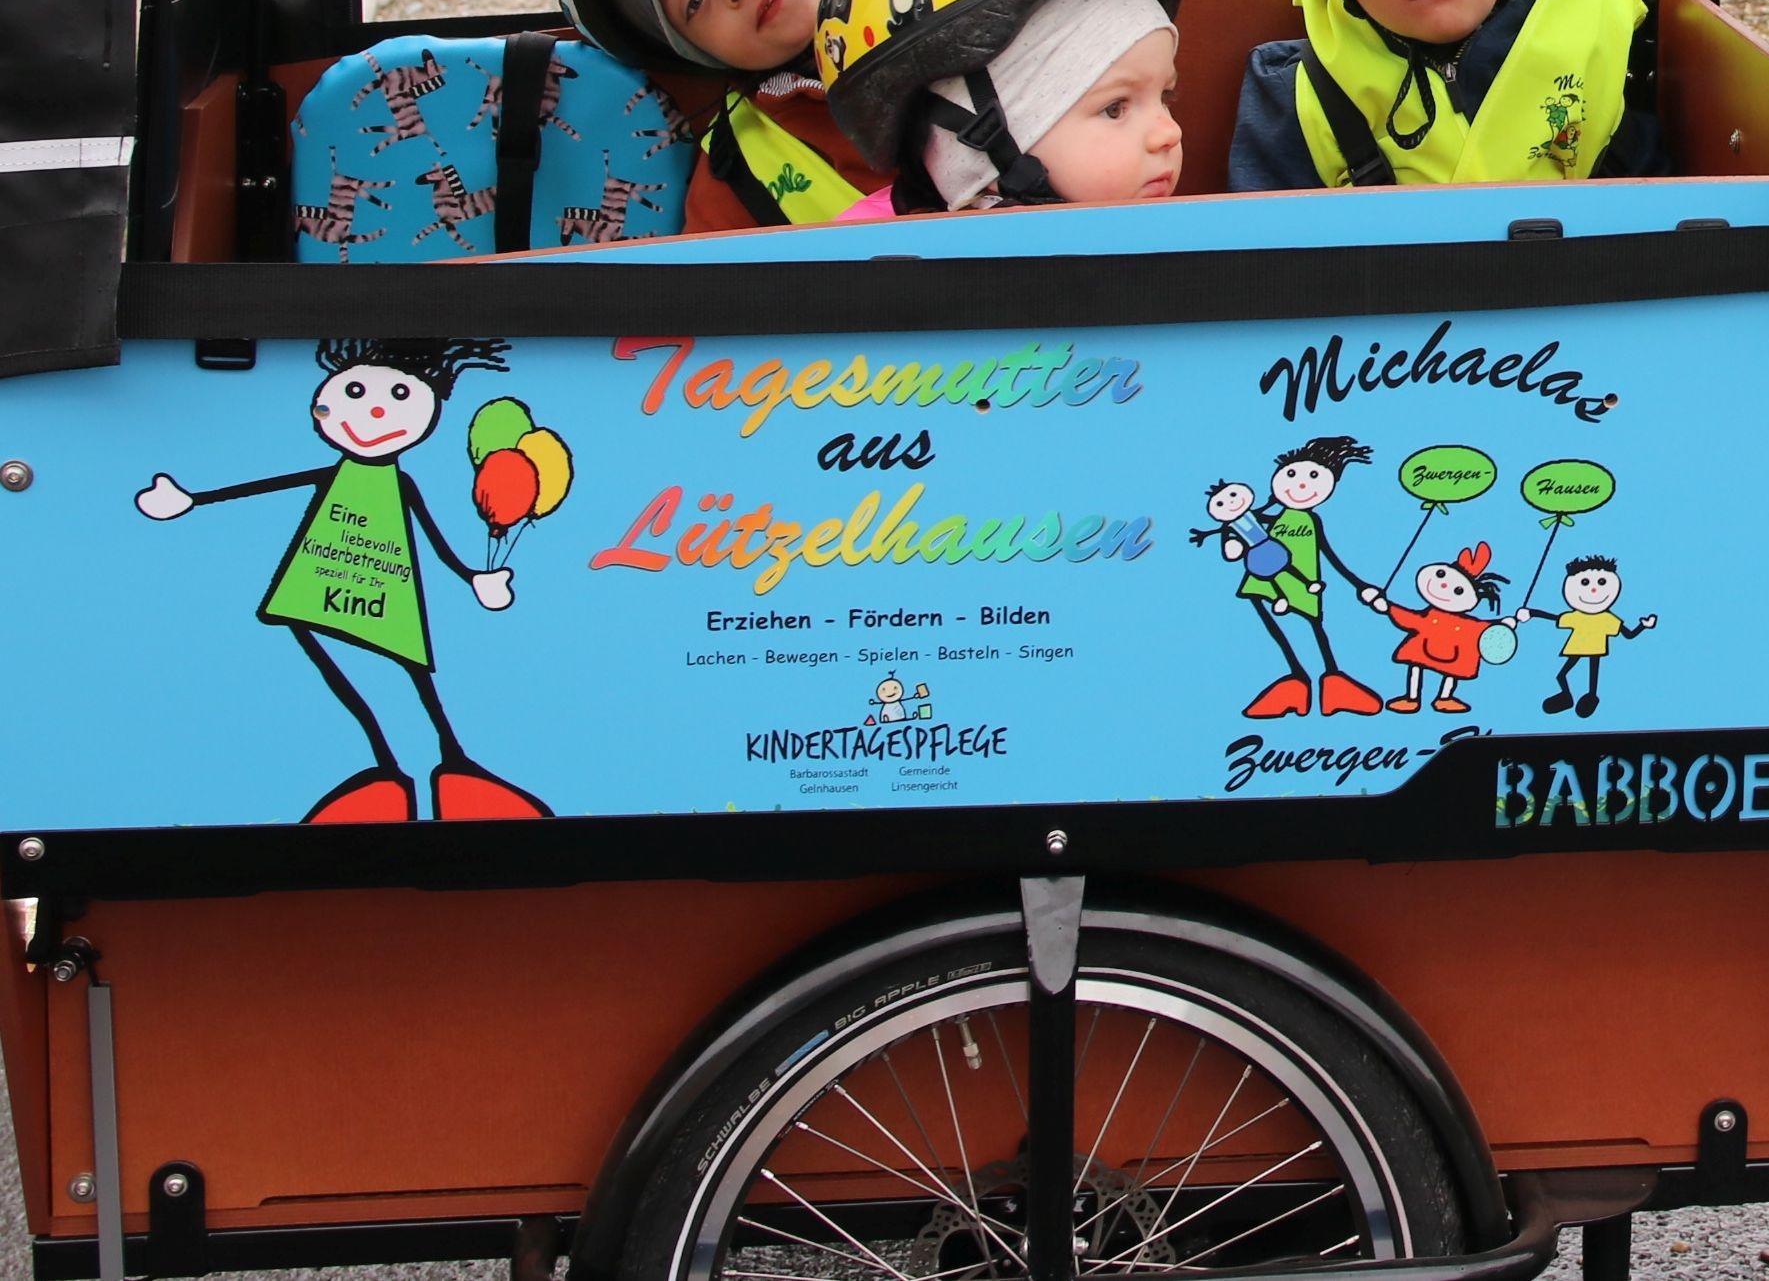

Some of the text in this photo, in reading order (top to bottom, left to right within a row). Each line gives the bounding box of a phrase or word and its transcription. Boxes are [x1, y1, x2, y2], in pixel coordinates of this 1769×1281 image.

[1261, 320, 1618, 424] Michaelas
[611, 337, 1144, 439] Tagesmutter
[817, 429, 936, 473] aus
[1412, 465, 1492, 487] Zwergen-
[1536, 478, 1600, 496] Hausen
[329, 503, 368, 528] Eine
[340, 529, 402, 556] liebevolle
[589, 483, 1155, 595] Lützelhausen
[1273, 523, 1313, 537] Hallo
[301, 536, 411, 583] Kinderbetreuung
[314, 566, 348, 580] speziell
[369, 577, 385, 589] Ihr
[323, 586, 386, 618] Kind
[706, 609, 812, 632] Erziehen
[848, 607, 943, 629] Fördern
[980, 605, 1051, 626] Bilden
[686, 650, 747, 666] Lachen
[765, 649, 839, 668] Bewegen
[857, 646, 919, 666] Spielen
[937, 645, 1000, 661] Basteln
[1018, 645, 1074, 663] Singen
[746, 725, 1008, 764] KINDERTAGESPFLEGE
[899, 765, 951, 777] Gemeinde
[1224, 725, 1493, 793] Zwergen-
[789, 767, 869, 780] Barbarossastadt
[799, 783, 860, 795] Gelnhausen
[891, 781, 958, 794] Linsengericht
[834, 974, 940, 1031] BIG APPLE
[697, 1078, 771, 1173] SCHWALBE
